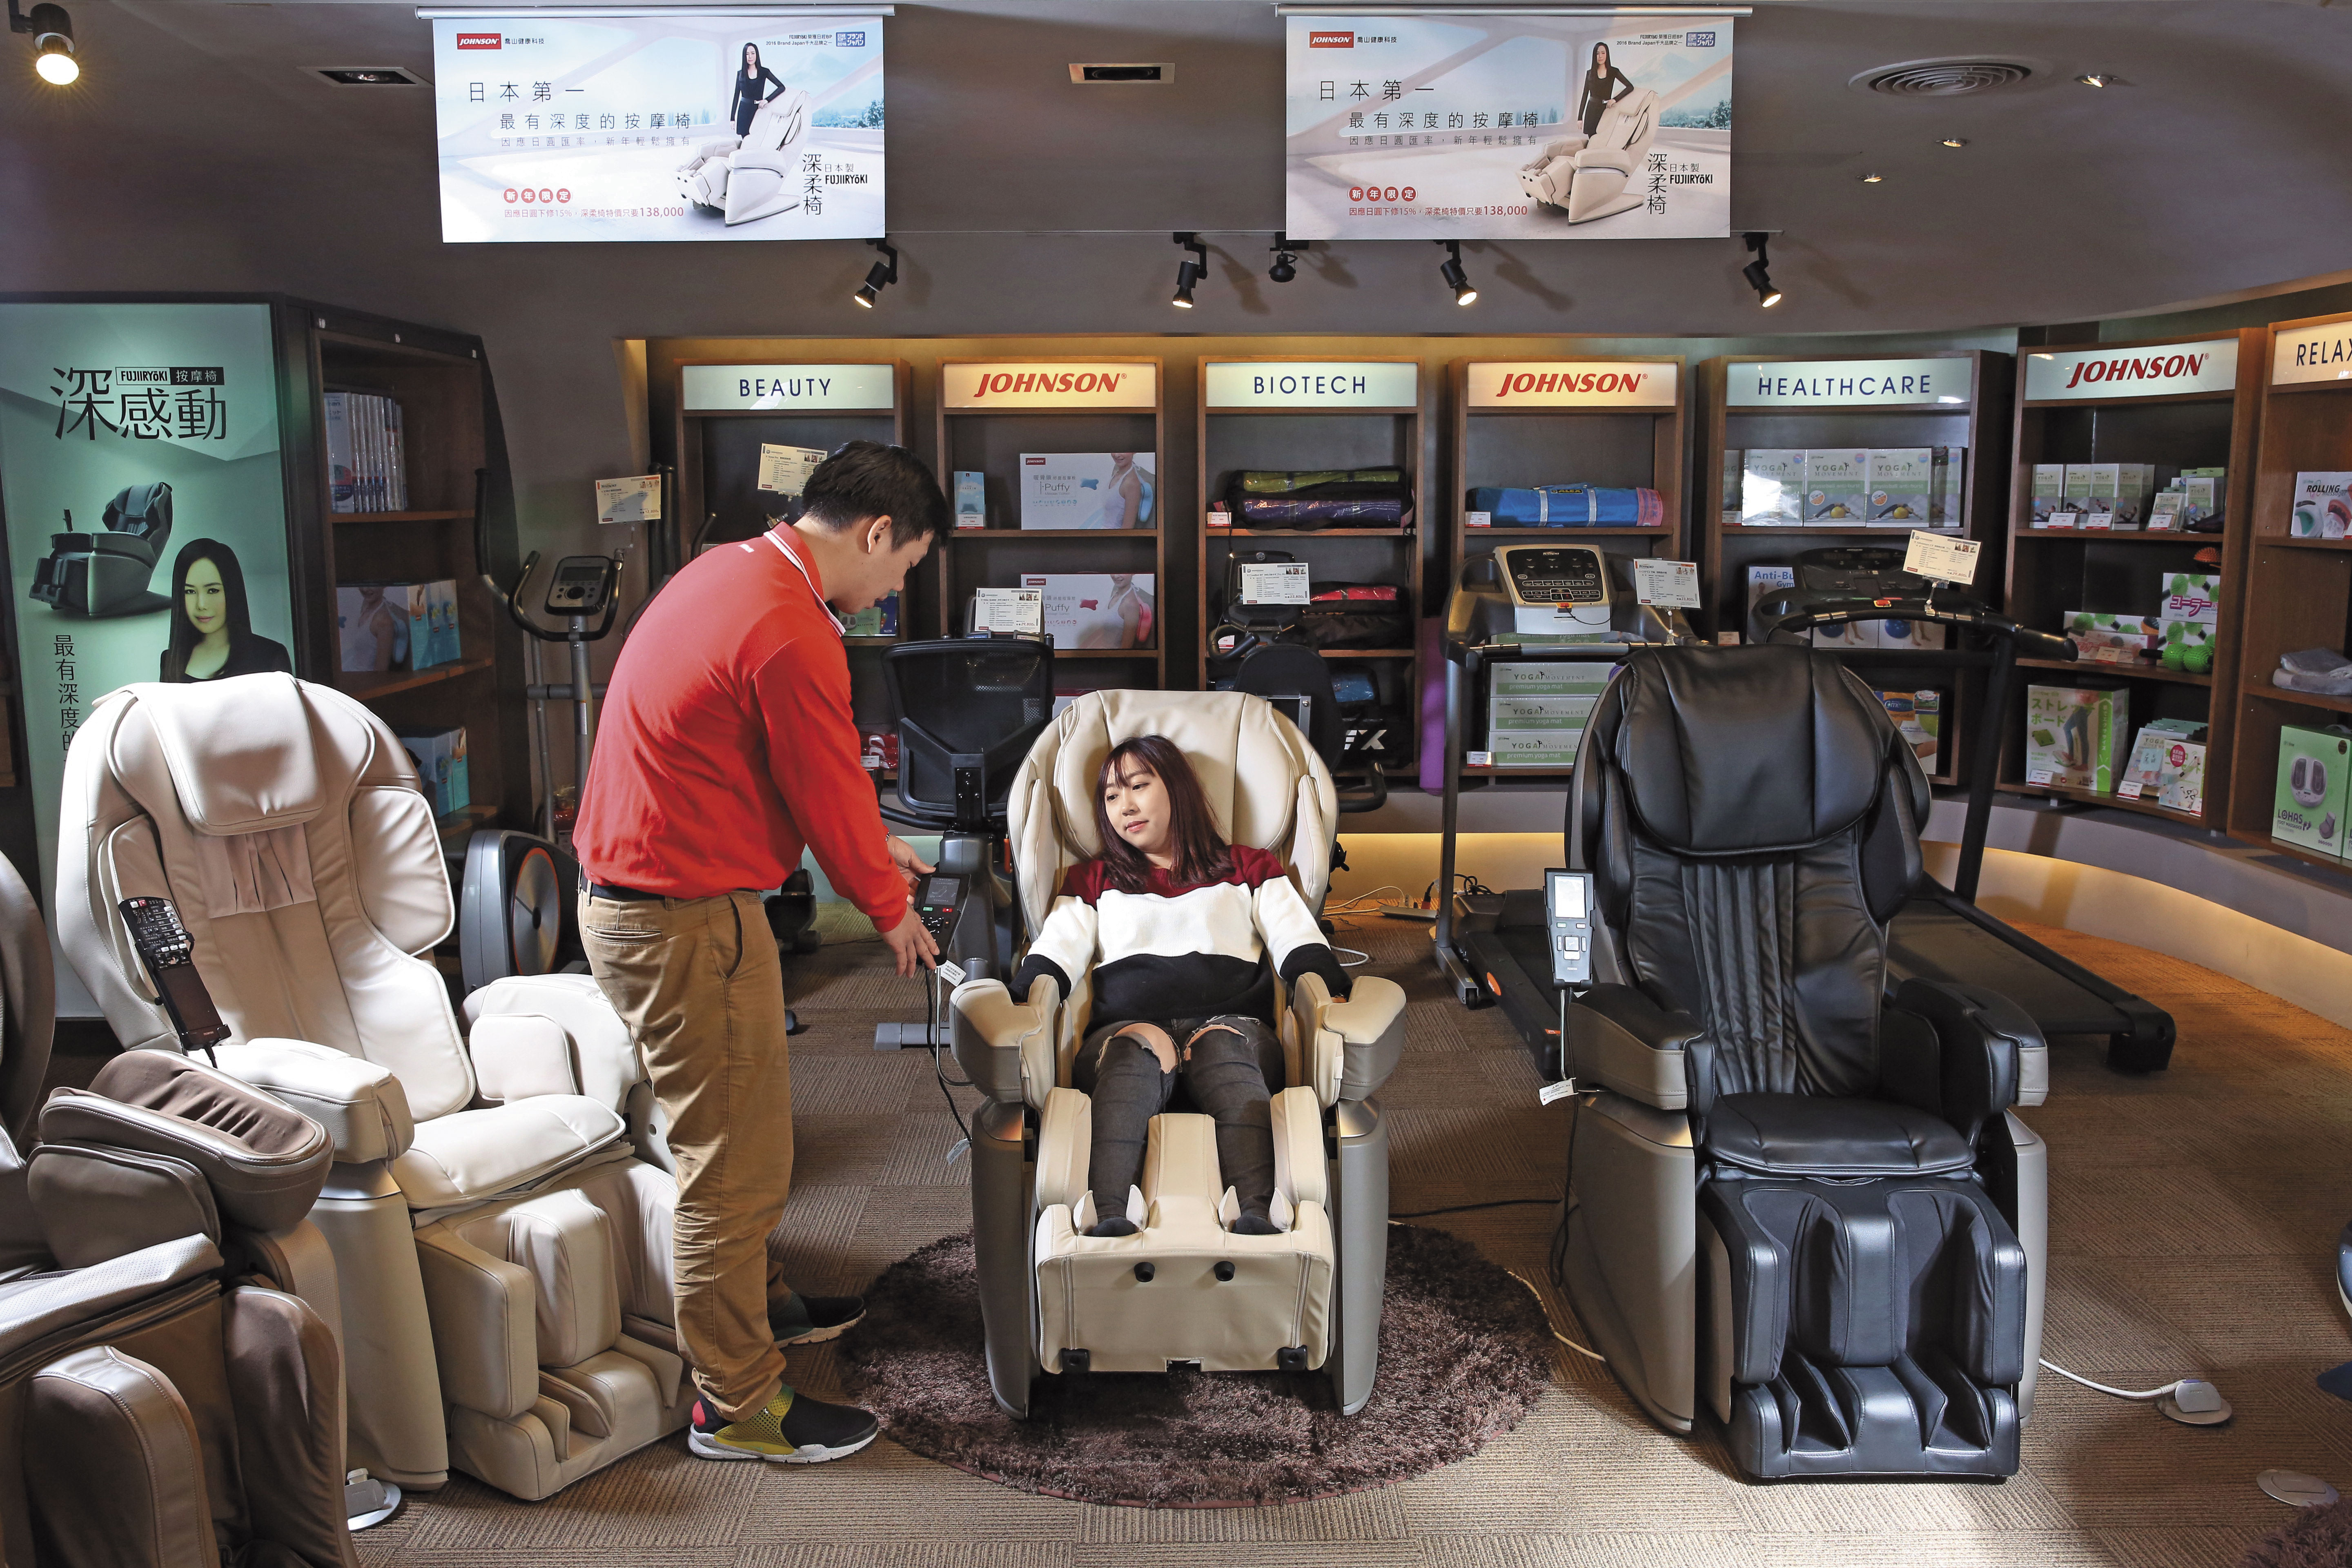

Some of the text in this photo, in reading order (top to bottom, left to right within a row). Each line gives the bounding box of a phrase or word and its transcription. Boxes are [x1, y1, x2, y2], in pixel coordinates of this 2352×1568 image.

[470, 81, 584, 102] 日本第一
[1320, 79, 1434, 102] 日本第一
[500, 113, 690, 130] 最有深度的按摩椅
[1349, 111, 1539, 129] 最有深度的按摩椅
[825, 163, 854, 173] 日本製
[1670, 163, 1699, 173] 日本製
[802, 154, 823, 216] 深柔椅
[1646, 153, 1668, 215] 深柔椅
[505, 189, 570, 202] 新年限定
[1350, 188, 1416, 200] 新年限定
[176, 370, 217, 382] 按摩椅
[1254, 375, 1366, 394] BIOTECH
[739, 379, 831, 397] BEAUTY
[1758, 374, 1931, 396] HEALTHCARE
[50, 367, 226, 441] 深感動
[2306, 485, 2341, 493] ROLLING
[1754, 571, 1794, 579] Anti-Bu
[1045, 604, 1070, 612] Puffy
[53, 635, 80, 762] 最有深度的
[2031, 713, 2067, 727] ボード
[2278, 808, 2303, 824] LOHAS
